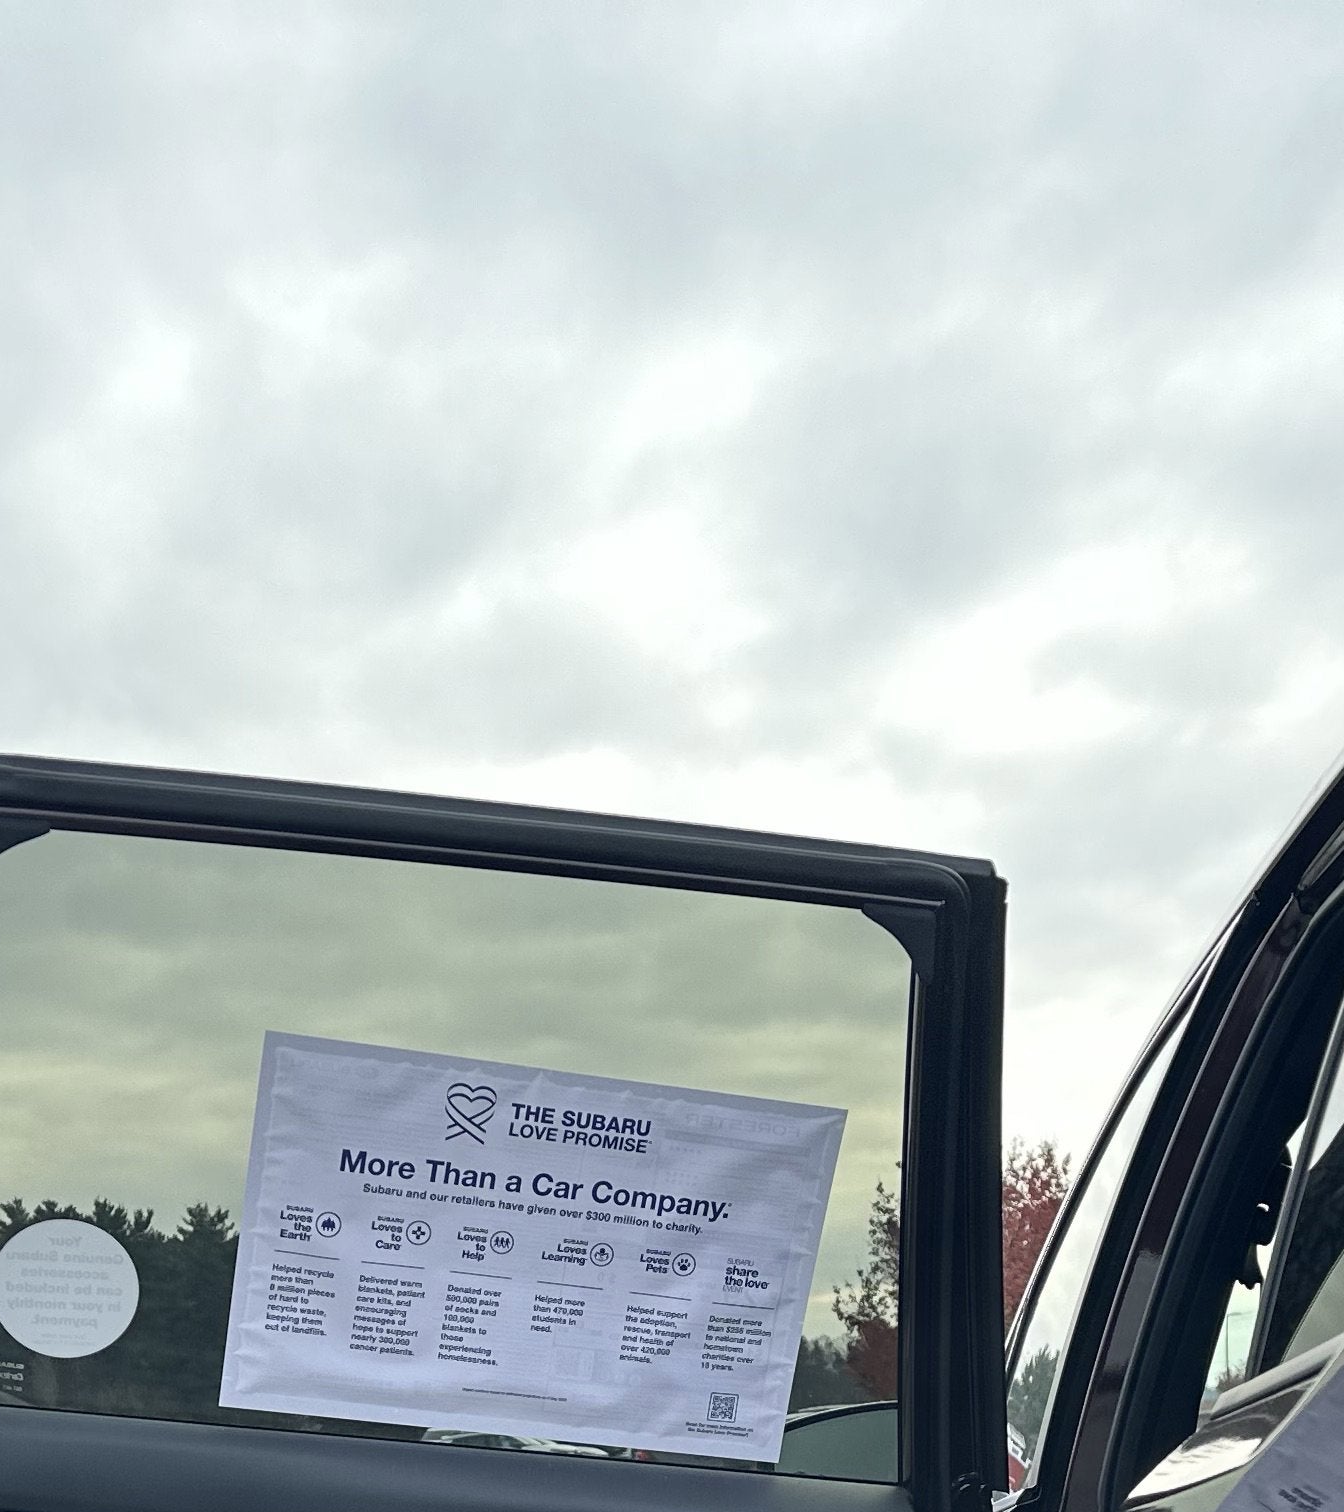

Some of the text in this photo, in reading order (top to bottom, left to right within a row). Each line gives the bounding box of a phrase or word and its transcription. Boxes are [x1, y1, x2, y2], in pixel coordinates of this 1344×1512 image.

[511, 1102, 651, 1136] THE SUBARU
[508, 1121, 648, 1153] LOVE PROMISE
[339, 1148, 731, 1222] More Than a Car Company.
[362, 1182, 703, 1236] Subaru and our retailers have given over $300 million to charity.
[279, 1209, 312, 1223] Loves
[293, 1221, 312, 1232] the
[370, 1220, 403, 1233] Loves
[279, 1228, 312, 1242] Earth
[390, 1232, 402, 1242] to
[456, 1230, 487, 1243] Loves
[374, 1239, 402, 1251] Care
[475, 1242, 486, 1252] to
[556, 1242, 587, 1255] Loves
[461, 1249, 486, 1262] Help
[540, 1250, 588, 1266] Learning
[639, 1253, 670, 1265] Loves
[271, 1262, 334, 1279] Helped recycle
[645, 1263, 668, 1274] Pets
[725, 1264, 759, 1278] share
[294, 1275, 314, 1285] than
[358, 1274, 422, 1288] Delivered warm
[724, 1275, 770, 1289] the love
[306, 1287, 335, 1298] pieces
[396, 1289, 425, 1298] patient
[446, 1283, 502, 1297] Donated over
[278, 1293, 298, 1303] hard
[300, 1296, 309, 1304] to
[355, 1295, 375, 1303] care
[395, 1299, 411, 1307] and
[478, 1298, 499, 1307] pairs
[534, 1293, 585, 1307] Helped more
[266, 1303, 298, 1313] recycle
[454, 1306, 479, 1314] socks
[532, 1304, 551, 1313] than
[626, 1304, 688, 1319] Helped support
[265, 1311, 322, 1326] keeping them
[353, 1314, 406, 1326] messages of
[531, 1314, 576, 1325] students in
[624, 1314, 638, 1323] the
[264, 1323, 279, 1331] out
[280, 1324, 290, 1332] of
[351, 1322, 418, 1337] hope to support
[441, 1322, 487, 1335] blankets to
[654, 1328, 691, 1339] transport
[350, 1333, 377, 1343] nearly
[440, 1332, 464, 1342] those
[621, 1334, 638, 1342] and
[638, 1335, 664, 1346] health
[349, 1343, 378, 1352] cancer
[438, 1343, 492, 1357] experiencing
[620, 1344, 639, 1352] over
